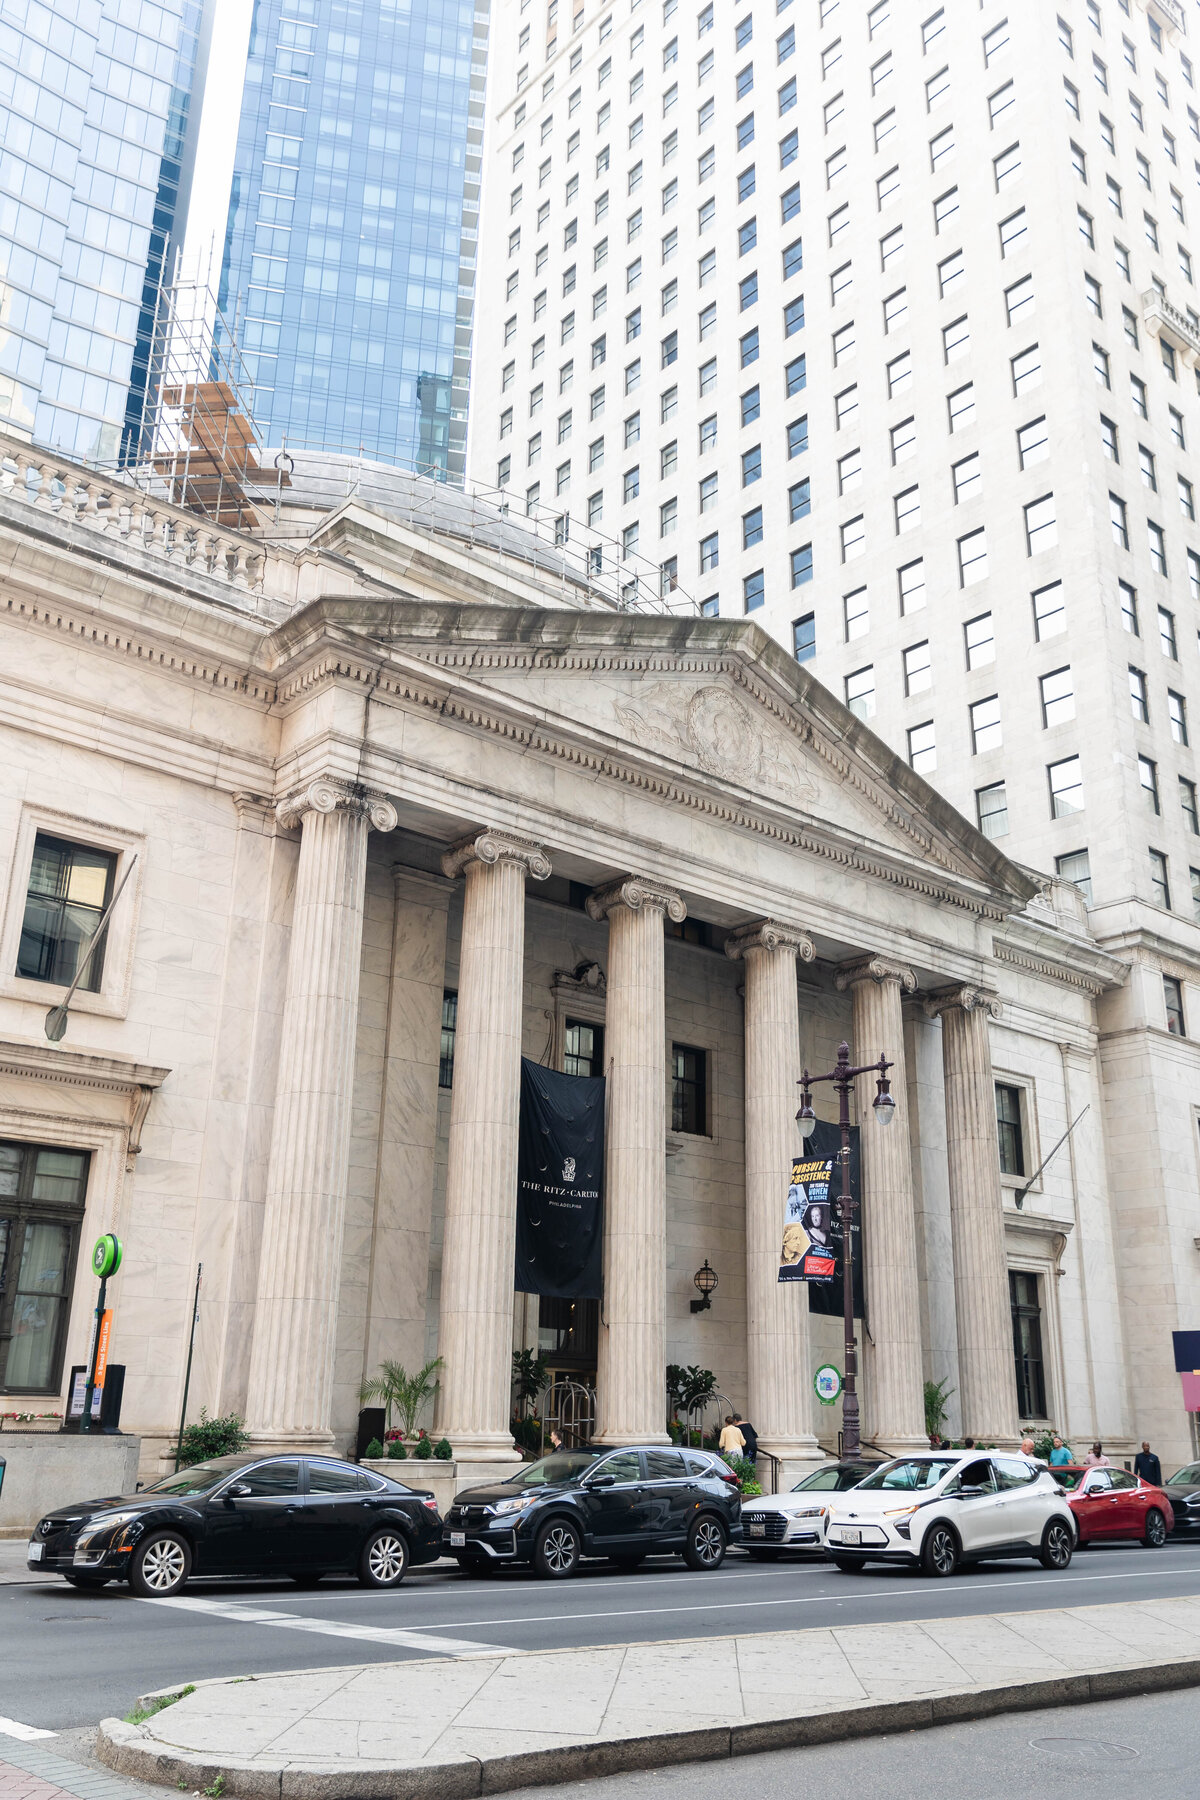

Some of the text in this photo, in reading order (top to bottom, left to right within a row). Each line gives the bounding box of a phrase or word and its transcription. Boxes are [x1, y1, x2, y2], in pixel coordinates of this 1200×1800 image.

[792, 1160, 832, 1174] PURSUIT &
[521, 1181, 540, 1191] THE
[809, 1187, 828, 1196] WOMEN
[548, 1200, 582, 1209] PHILADELPHIA
[97, 1353, 105, 1370] Broad
